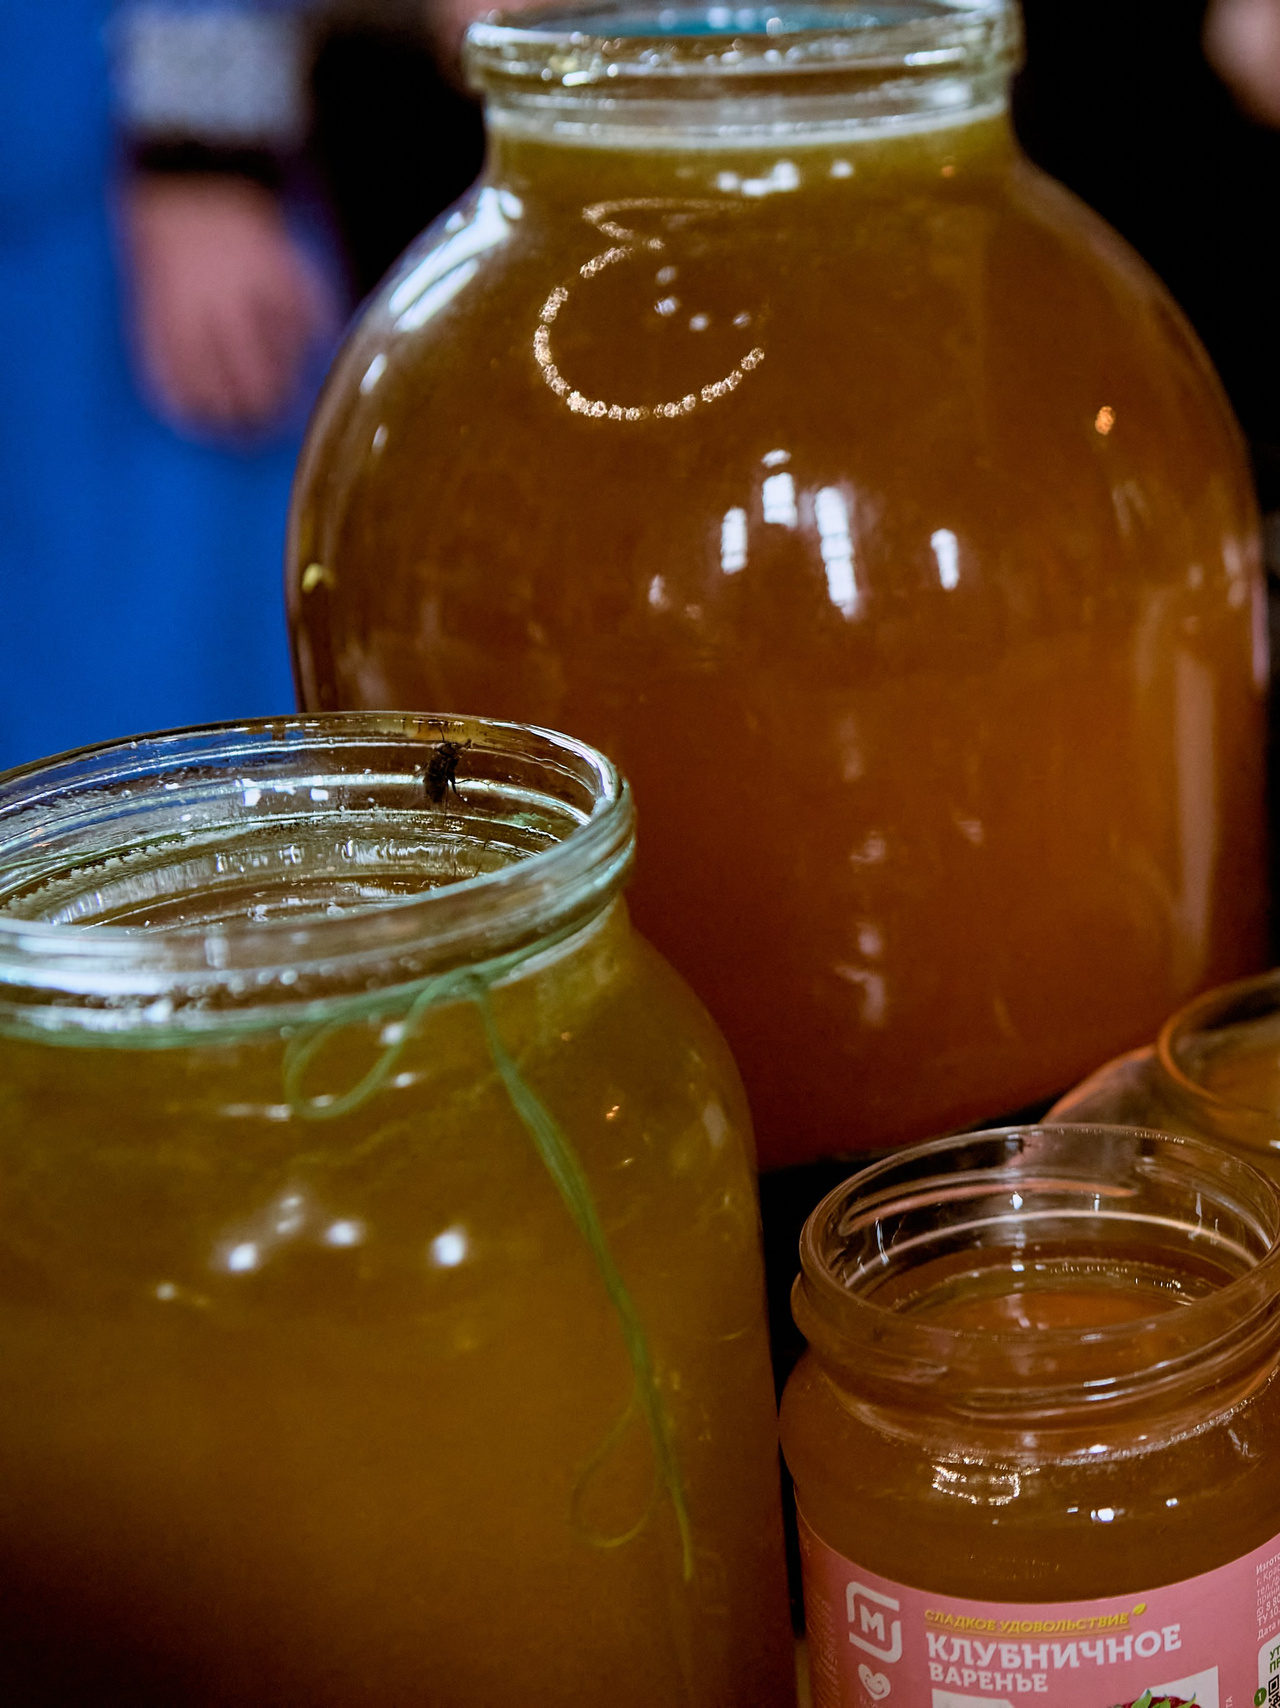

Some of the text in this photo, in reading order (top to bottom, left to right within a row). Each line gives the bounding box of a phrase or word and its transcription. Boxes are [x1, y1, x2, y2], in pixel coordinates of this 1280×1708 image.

[924, 1609, 1130, 1634] СЛАДКОЕ УДОВОЛЬСТВИЕ
[1257, 1612, 1267, 1627] ТУ
[1257, 1619, 1275, 1641] Дата
[926, 1624, 1182, 1670] КЛУБНИЧНОЕ
[928, 1661, 1048, 1693] ВАРЕНЬЕ
